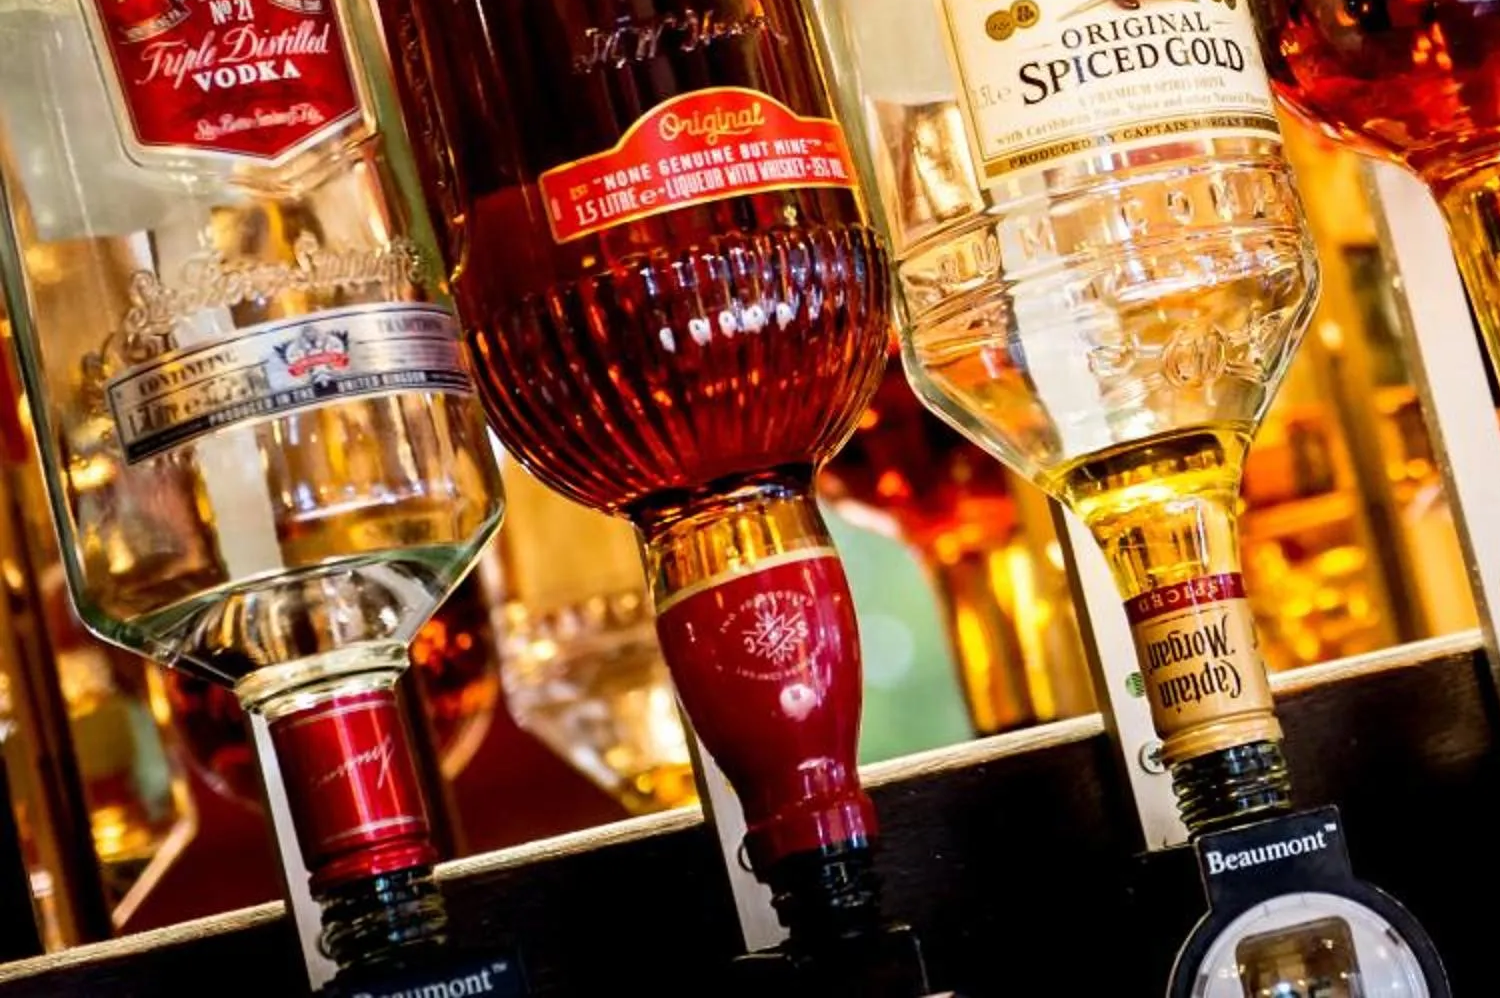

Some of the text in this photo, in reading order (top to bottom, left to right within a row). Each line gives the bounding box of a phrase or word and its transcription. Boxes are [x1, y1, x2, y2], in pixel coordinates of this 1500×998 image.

[135, 26, 215, 90] Triple
[219, 21, 331, 63] Distilled
[1061, 10, 1212, 49] ORIGINAL
[192, 61, 303, 93] VODKA
[1018, 42, 1160, 105] SPICED
[1165, 36, 1246, 74] GOLD
[659, 102, 765, 146] Original
[1009, 139, 1092, 168] PRODUCED
[1122, 119, 1190, 142] CAPTAIN
[658, 147, 734, 176] GENUINE
[739, 140, 770, 159] BUT
[600, 187, 639, 218] LITRE
[725, 161, 758, 187] WITH
[1149, 613, 1237, 674] Morgan
[1159, 659, 1242, 714] Captain
